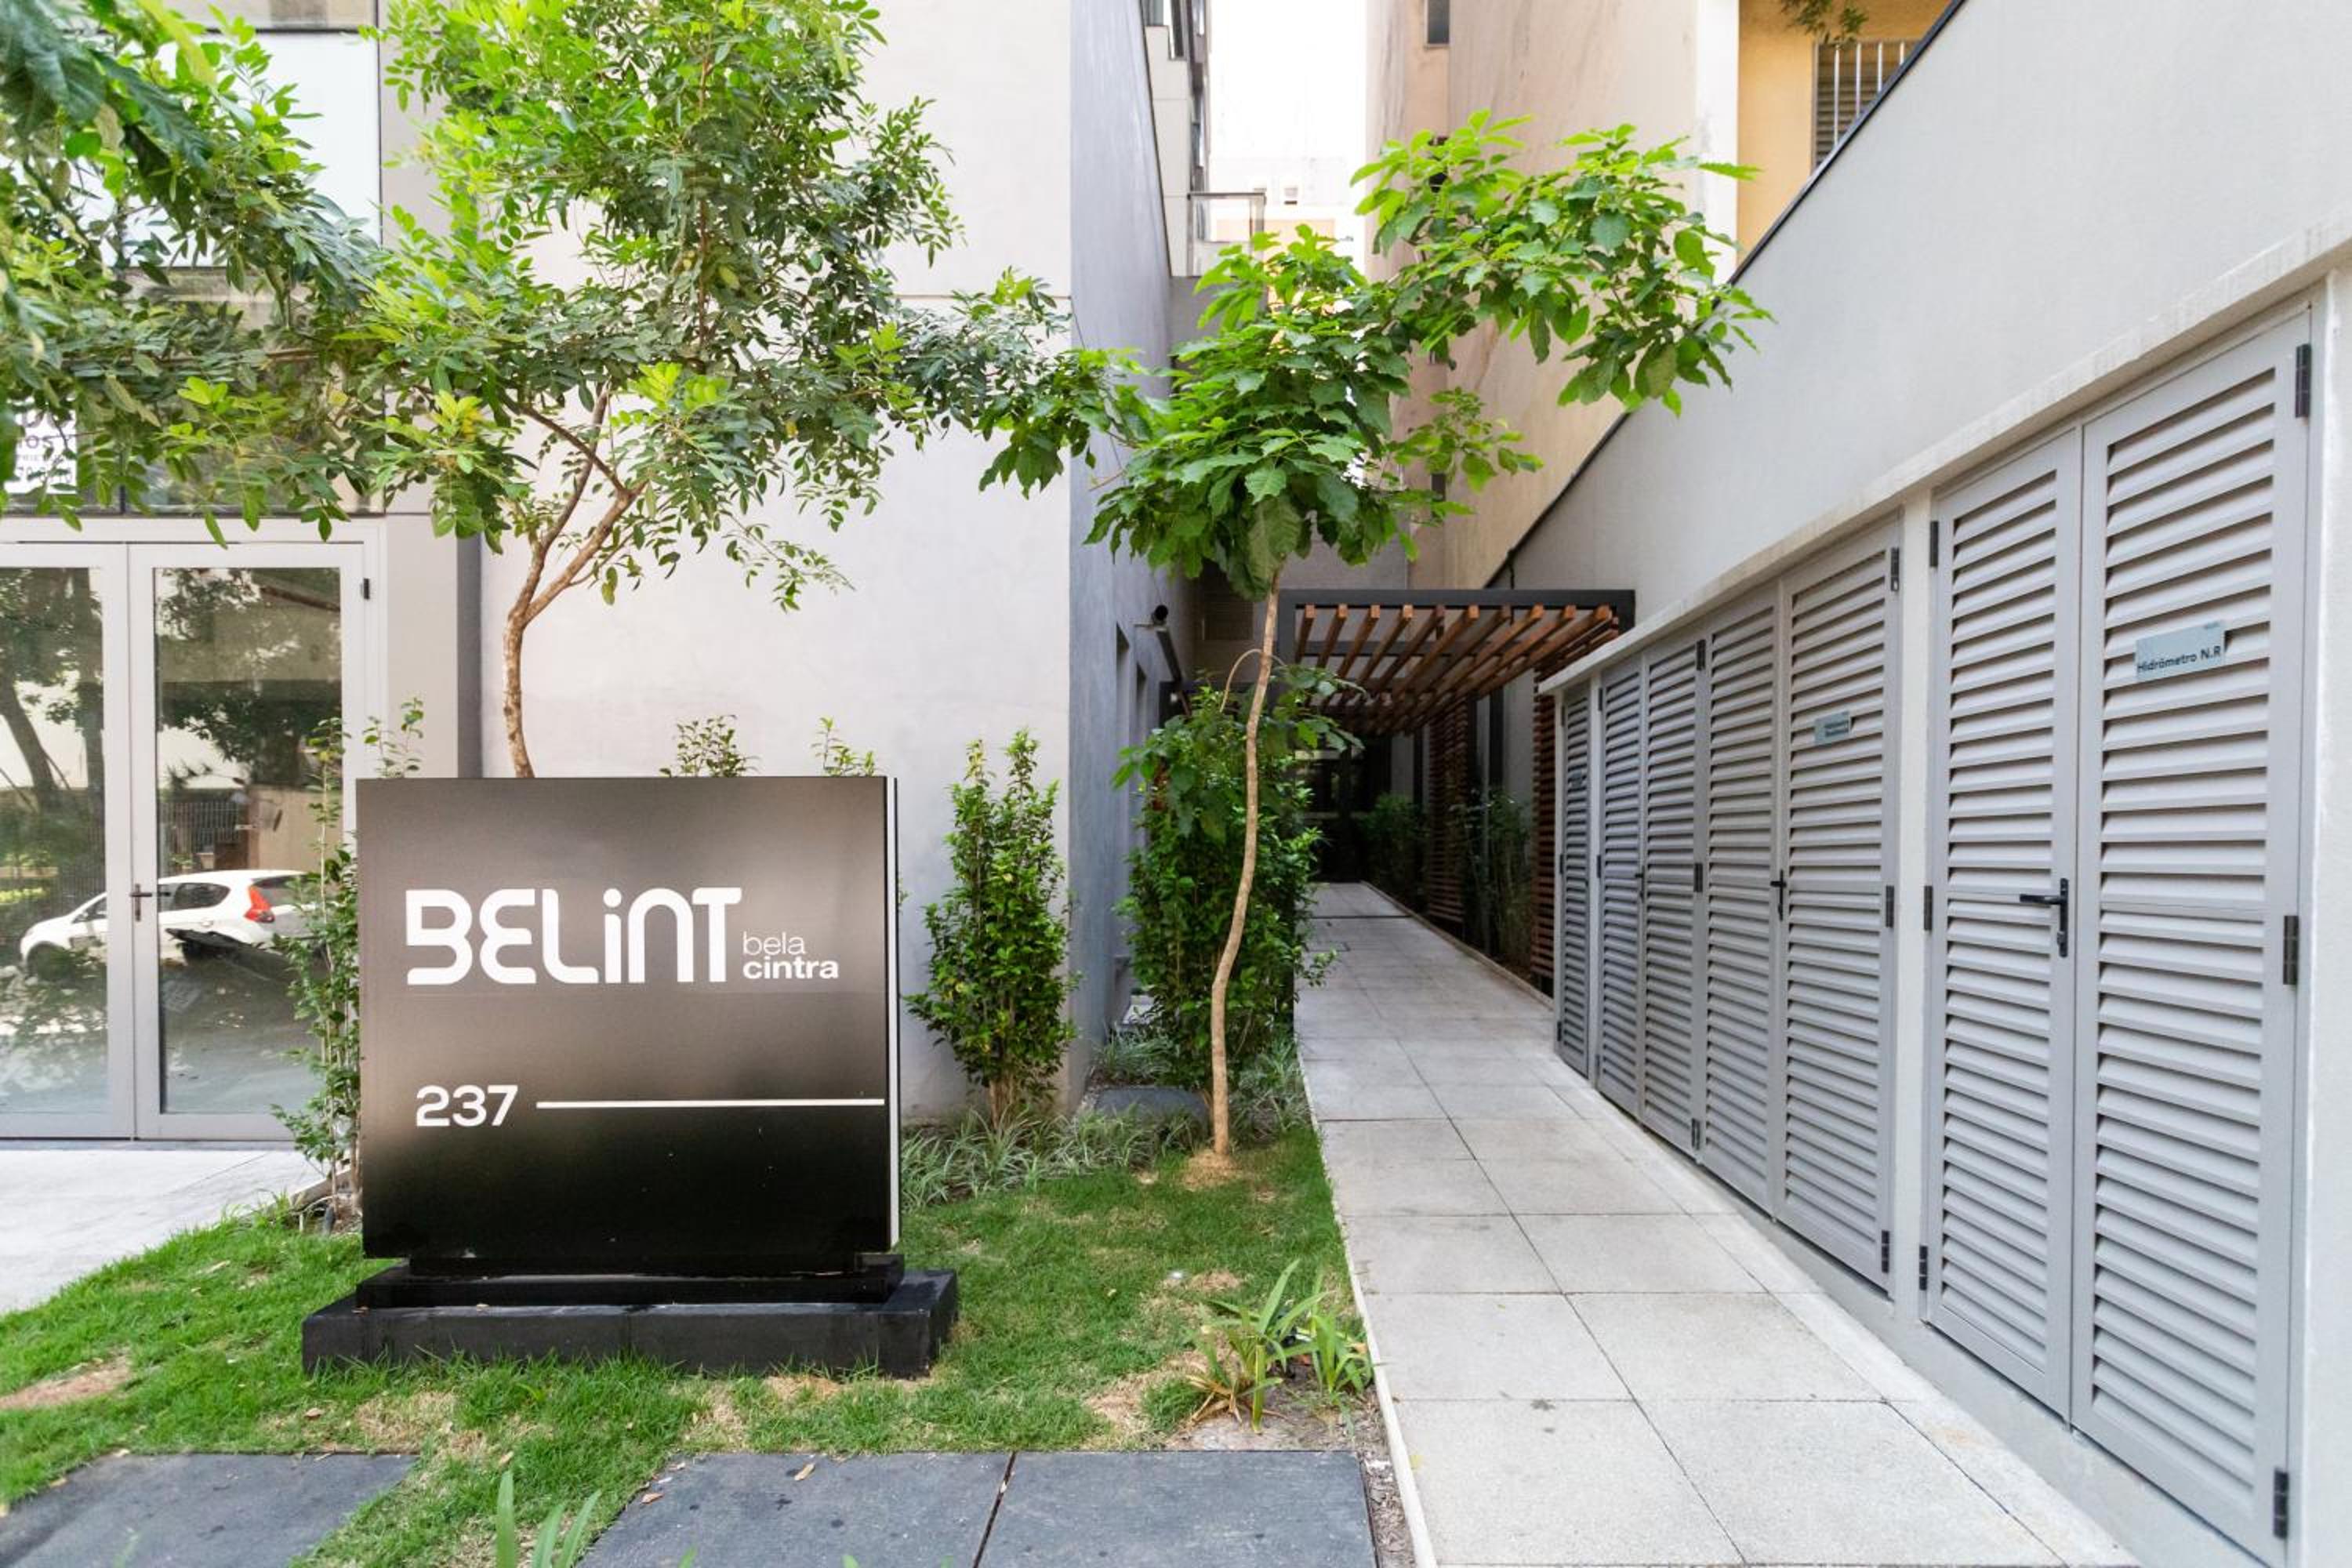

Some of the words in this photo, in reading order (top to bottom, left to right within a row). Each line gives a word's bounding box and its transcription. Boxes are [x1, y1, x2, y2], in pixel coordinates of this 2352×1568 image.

[742, 931, 806, 955] bela
[742, 956, 839, 979] cintra
[416, 1085, 518, 1127] 237
